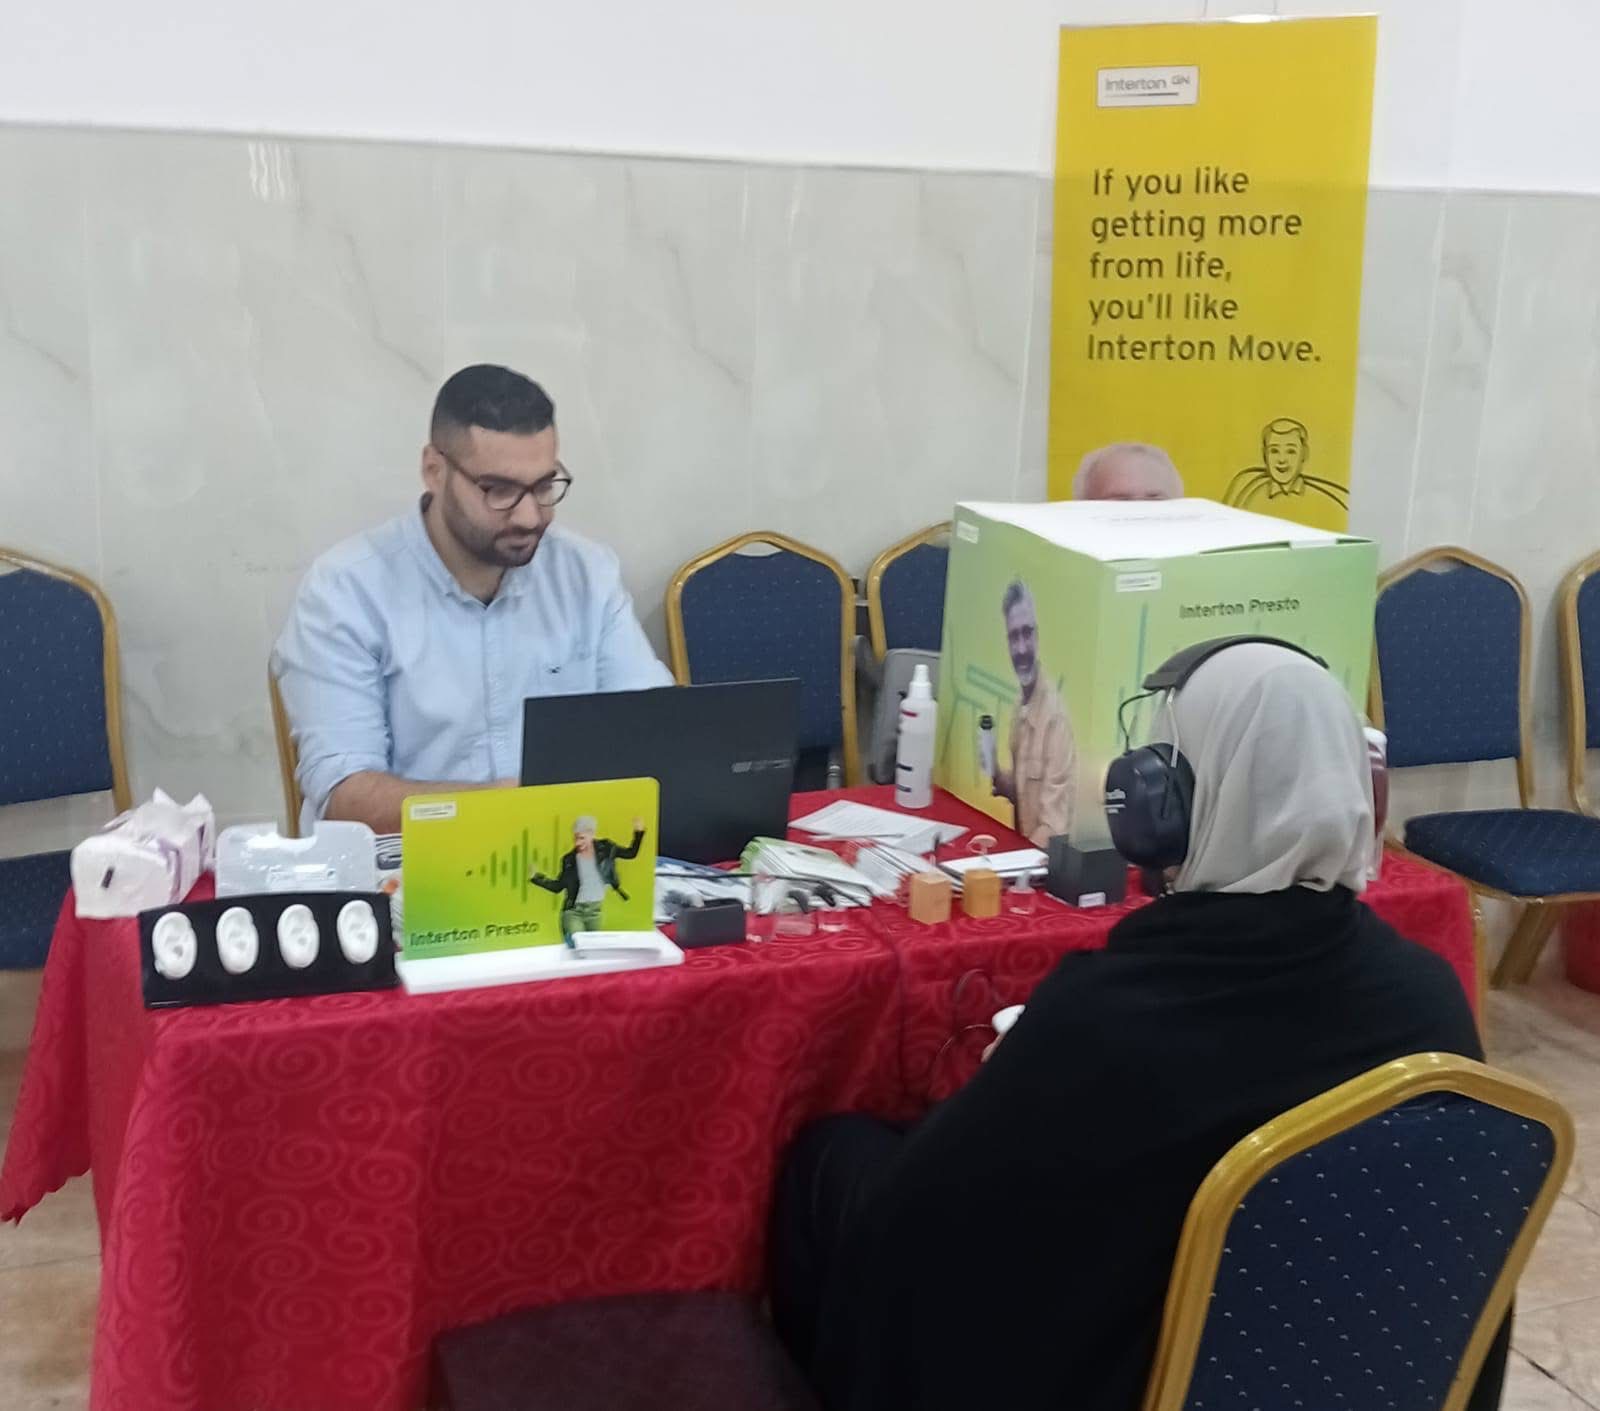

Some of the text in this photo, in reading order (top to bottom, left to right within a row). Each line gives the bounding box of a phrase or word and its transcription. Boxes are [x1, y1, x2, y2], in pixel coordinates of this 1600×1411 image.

[1093, 167, 1250, 201] If you like
[1091, 210, 1302, 243] getting more
[1089, 250, 1232, 282] from life,
[1088, 293, 1239, 325] you'll like
[1087, 334, 1321, 362] Interton Move.
[1179, 598, 1300, 619] Interton Presto
[410, 921, 539, 946] Interton Presto
